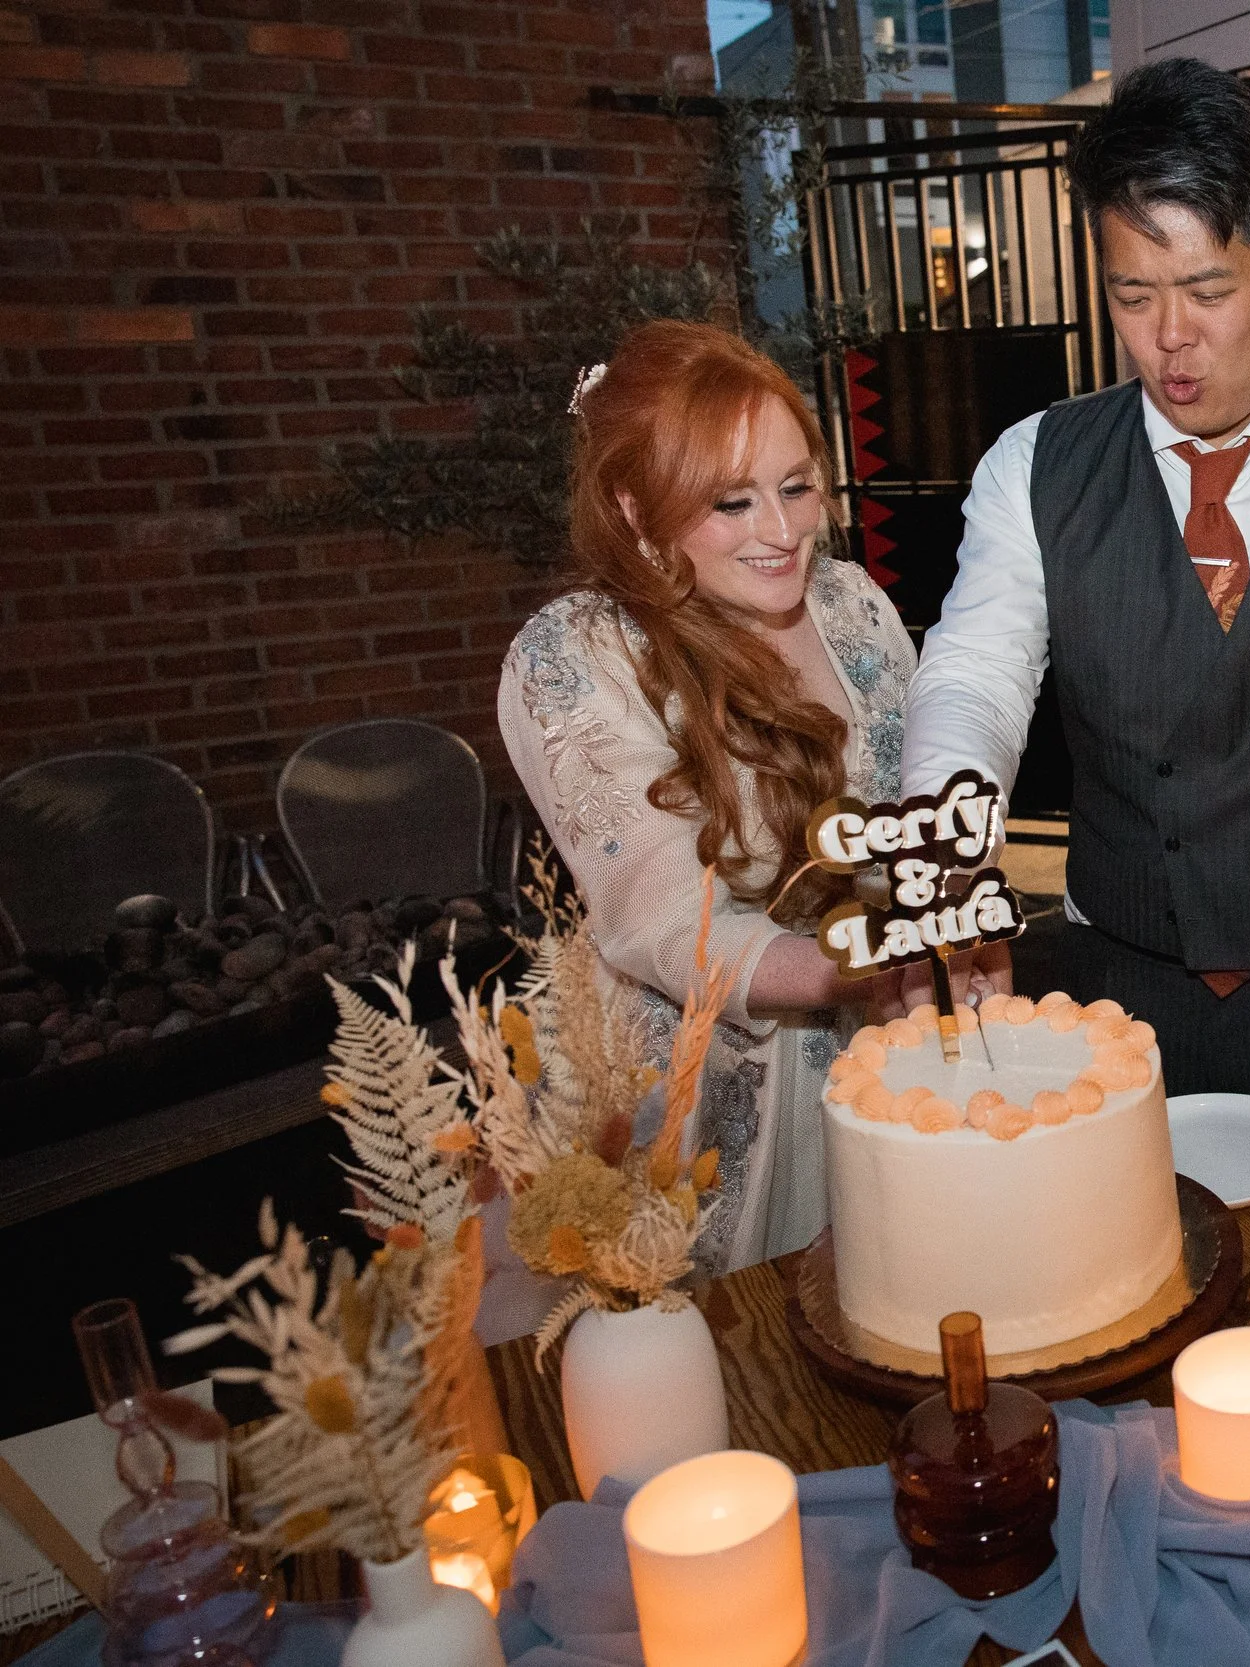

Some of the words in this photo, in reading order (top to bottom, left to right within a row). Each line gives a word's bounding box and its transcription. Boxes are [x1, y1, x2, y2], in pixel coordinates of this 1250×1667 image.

[817, 781, 994, 863] Gerry
[895, 859, 940, 907] &
[827, 881, 1017, 968] Laura
